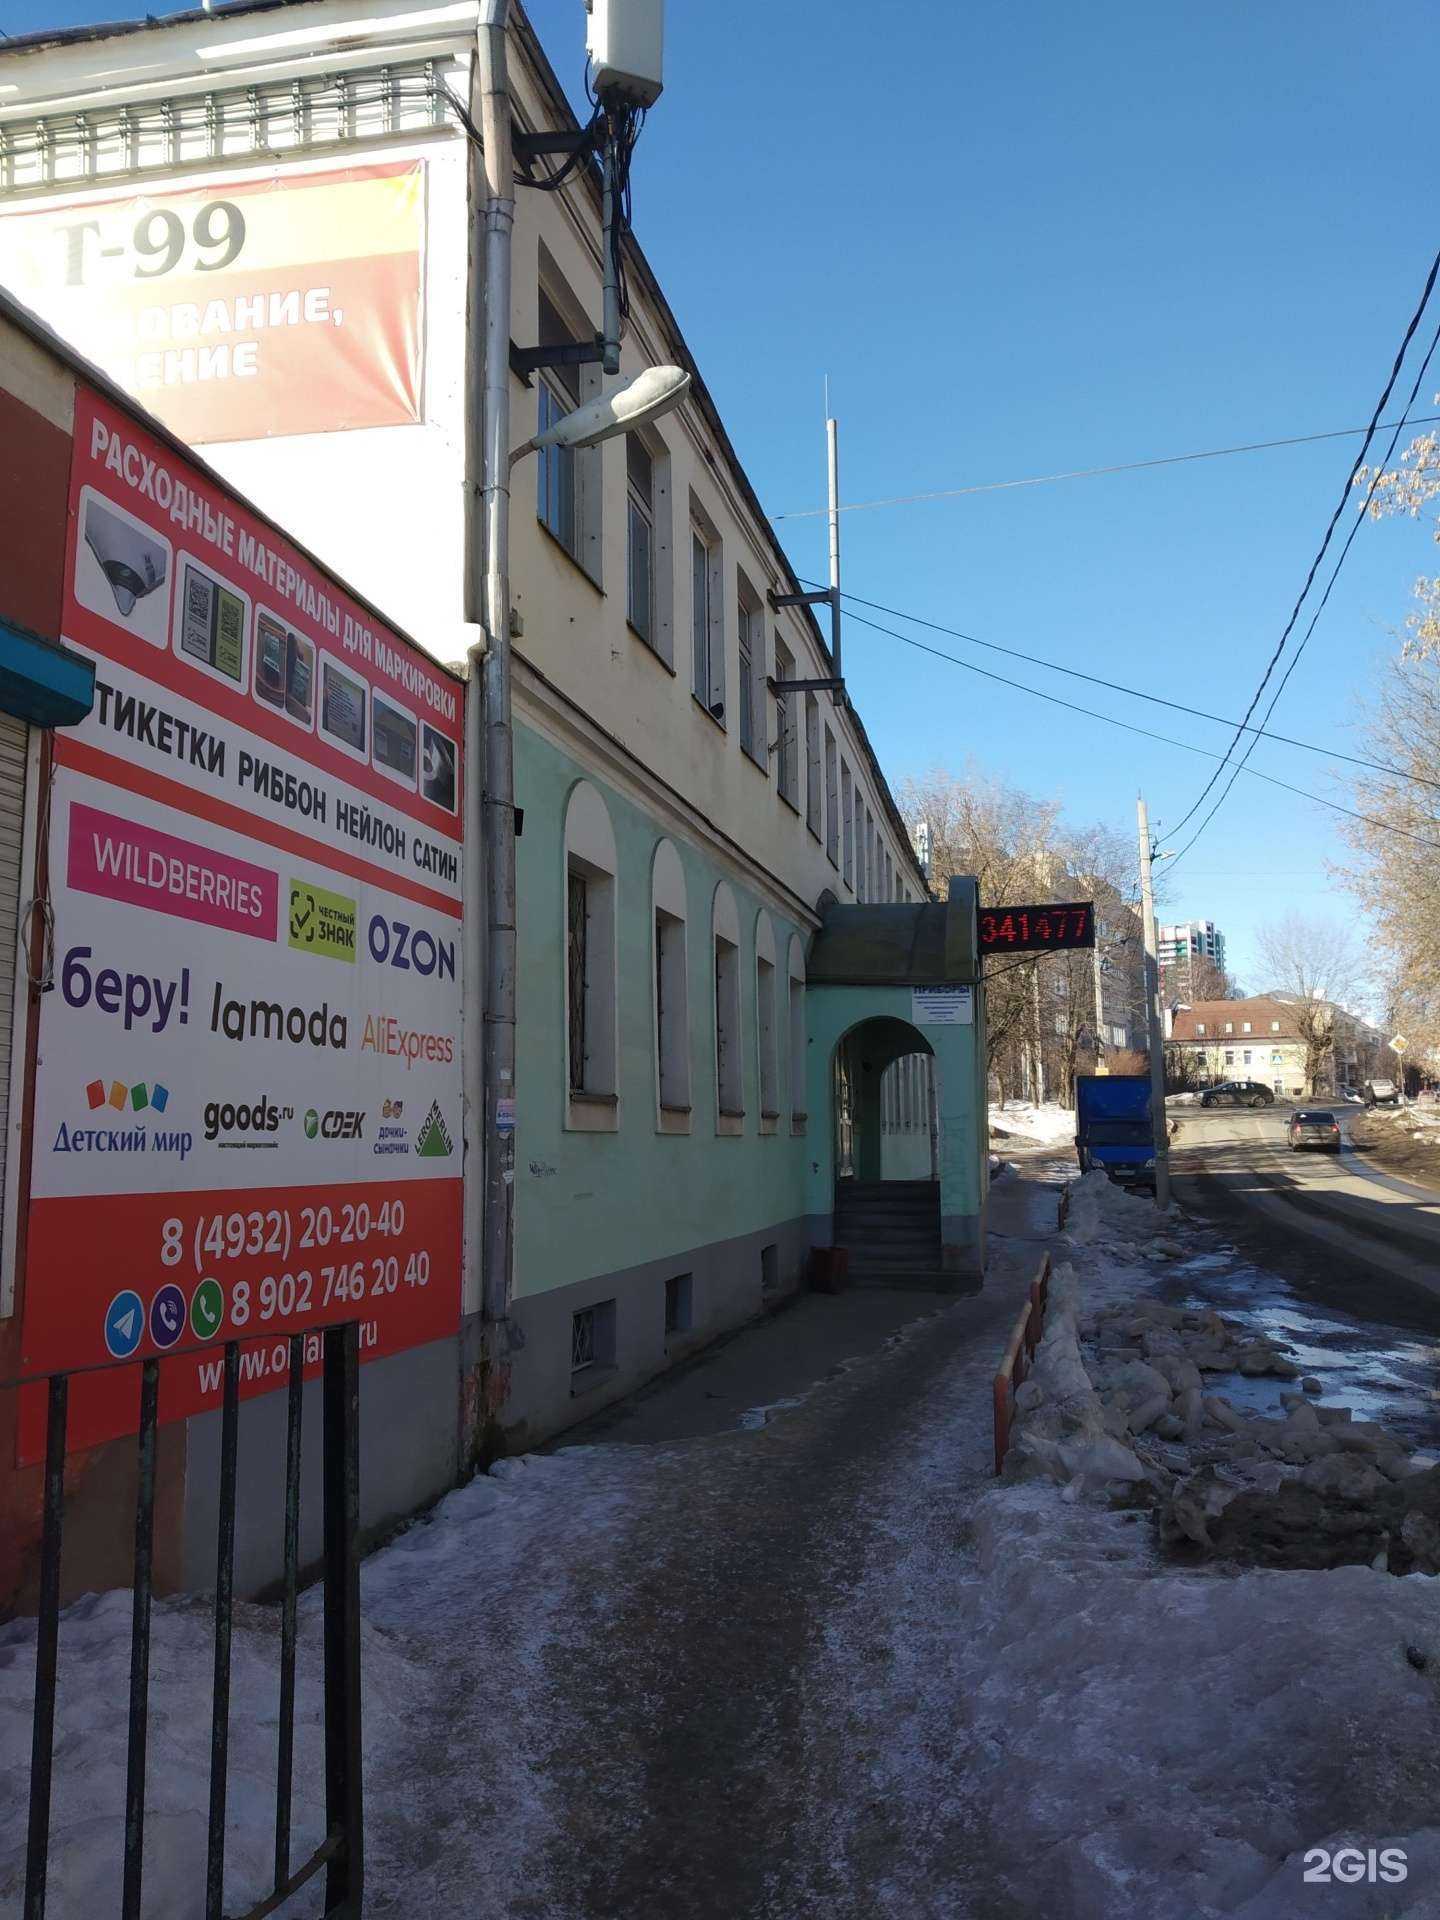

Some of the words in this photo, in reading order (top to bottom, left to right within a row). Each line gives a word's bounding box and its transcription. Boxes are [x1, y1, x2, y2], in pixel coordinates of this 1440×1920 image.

[54, 199, 247, 286] Т-99
[137, 286, 344, 340] ОВАНИЕ,
[134, 340, 260, 389] ЕНИЕ
[91, 417, 234, 554] РАСХОДНЫЕ
[238, 528, 340, 637] МАТЕРИАЛЫ
[342, 613, 372, 662] ДЛЯ
[374, 638, 456, 723] МАРКИРОВКИ
[95, 680, 226, 778] ТИКЕТКИ
[238, 750, 327, 824] РИББОН
[336, 799, 406, 861] НЕЙЛОН
[412, 832, 458, 884] САТИН
[92, 831, 263, 919] WILDBERRIES
[318, 905, 355, 926] ЧЕСТНЫЙ
[318, 921, 355, 949] ЗНАК
[368, 914, 456, 982] OZON
[61, 946, 190, 1034] беру!
[210, 981, 348, 1050] lamoda
[361, 1014, 454, 1070] AliExpress
[53, 1121, 147, 1154] Детский
[150, 1128, 193, 1161] мир
[203, 1094, 294, 1140] goods.ru
[321, 1110, 367, 1139] CDEK
[415, 1107, 435, 1154] LEROY
[430, 1098, 454, 1155] MERLIN
[160, 1217, 183, 1267] 8
[194, 1209, 291, 1273] (4932)
[300, 1199, 406, 1249] 20-20-40
[230, 1280, 251, 1326] 8
[259, 1270, 313, 1320] 902
[321, 1260, 365, 1304] 746
[371, 1255, 399, 1296] 20
[404, 1250, 430, 1288] 40
